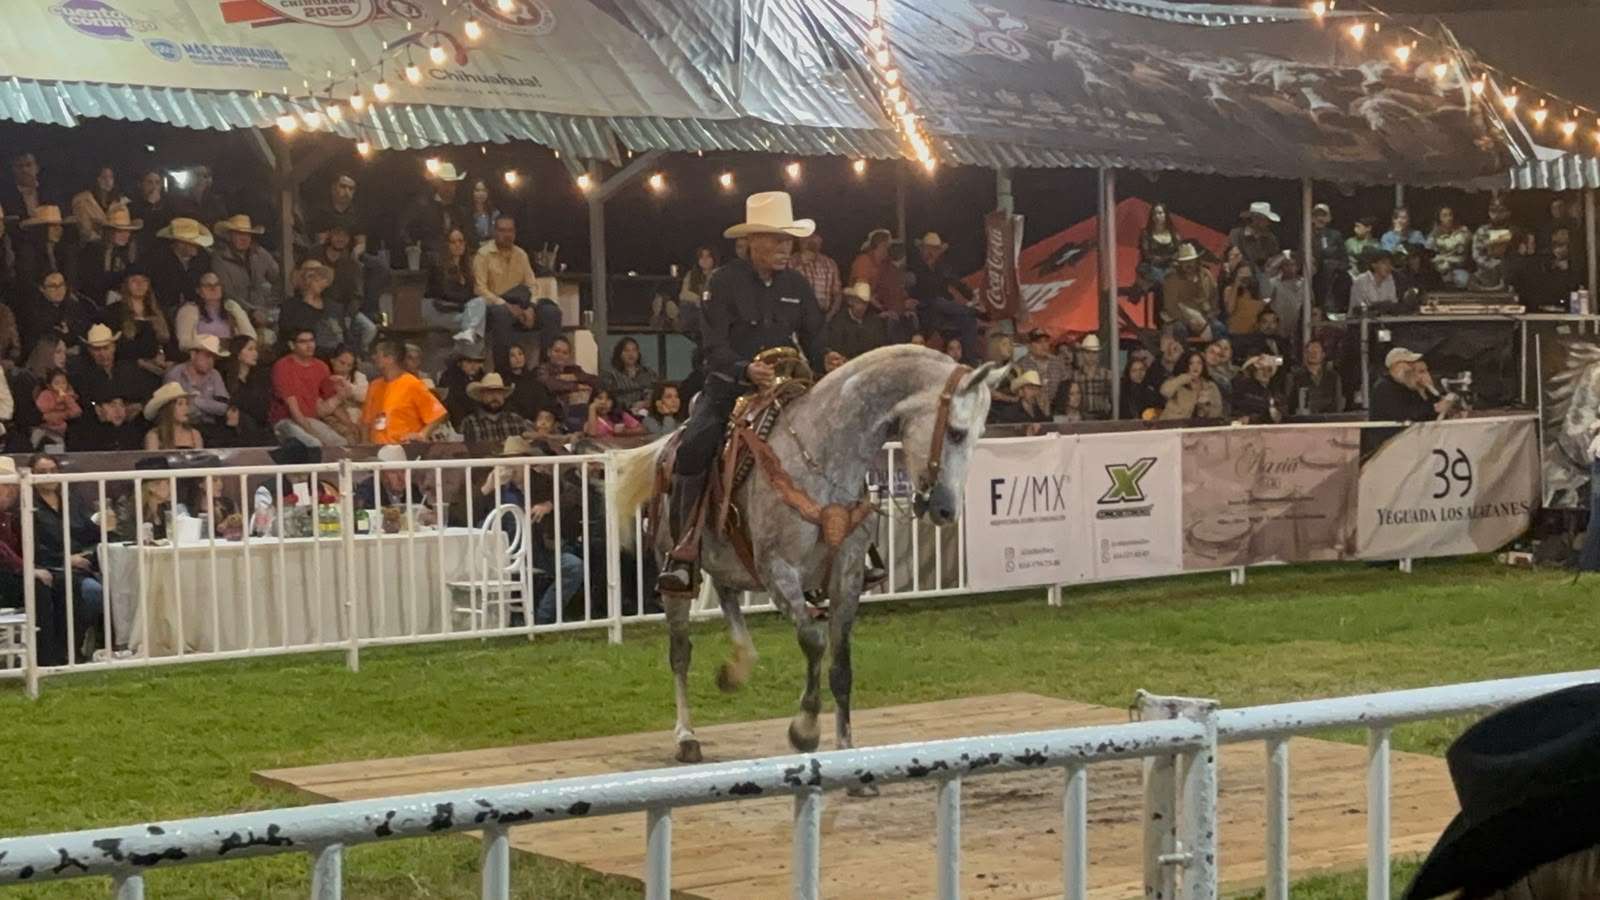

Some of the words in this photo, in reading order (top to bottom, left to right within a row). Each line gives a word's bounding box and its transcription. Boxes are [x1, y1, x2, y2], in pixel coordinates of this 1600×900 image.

[303, 5, 353, 17] 2026
[1432, 448, 1473, 499] 39
[1377, 508, 1437, 526] YEGUADA
[1440, 507, 1464, 522] LOS
